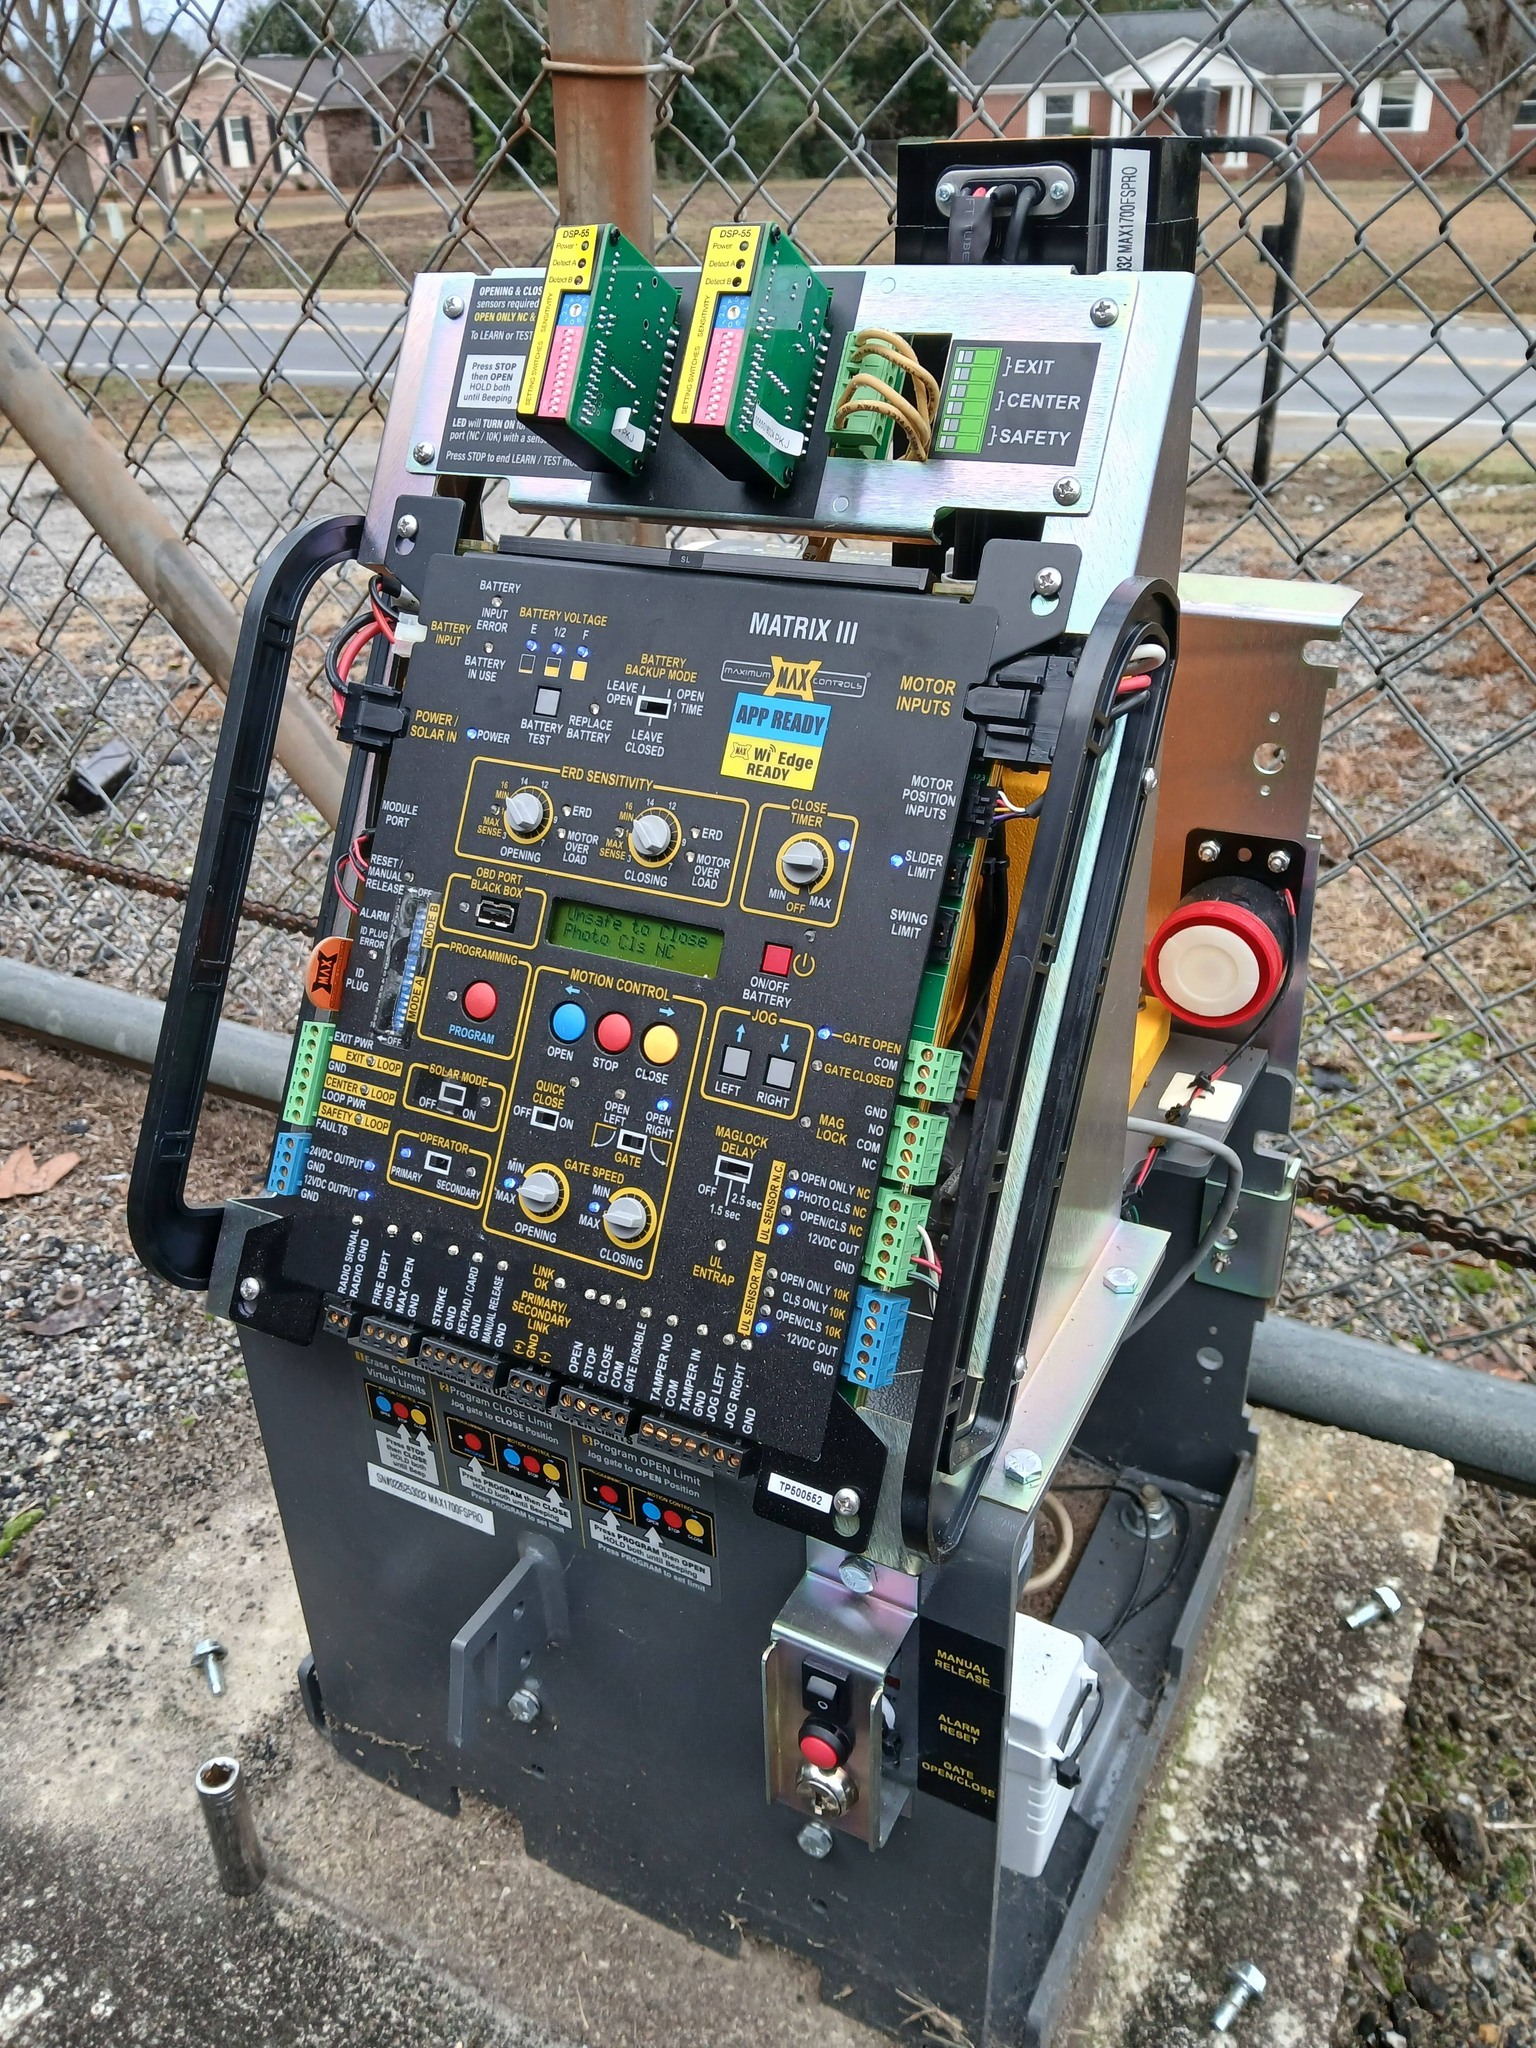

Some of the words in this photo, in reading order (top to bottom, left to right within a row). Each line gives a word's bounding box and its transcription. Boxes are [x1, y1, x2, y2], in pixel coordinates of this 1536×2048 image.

[1117, 166, 1138, 255] MAX1700FSPRO
[562, 229, 590, 238] DSP-55
[720, 229, 751, 238] DSP-55
[712, 242, 733, 250] Power
[479, 286, 514, 297] OPENING
[472, 362, 493, 372] Press
[495, 362, 517, 372] STOP
[1014, 360, 1054, 375] EXIT
[472, 372, 489, 382] then
[490, 373, 513, 382] OPEN
[469, 383, 491, 392] HOLD
[493, 383, 511, 393] both
[463, 393, 480, 402] until
[481, 394, 513, 405] Beeping
[1007, 393, 1081, 411] CENTER
[452, 418, 467, 428] LED
[467, 418, 481, 429] will
[483, 418, 502, 430] TURN
[503, 419, 515, 430] ON
[1000, 428, 1072, 446] SAFETY
[446, 451, 466, 462] Press
[467, 452, 486, 463] STOP
[487, 453, 495, 463] to
[496, 453, 510, 464] end
[511, 453, 536, 465] LEARN
[480, 580, 521, 594] BATTERY
[482, 607, 508, 620] INPUT
[519, 607, 562, 622] BATTERY
[564, 611, 608, 627] VOLTAGE
[431, 620, 471, 635] BATTERY
[476, 620, 508, 634] ERROR
[749, 612, 832, 642] MATRIX
[836, 620, 859, 645] III
[435, 633, 462, 646] INPUT
[465, 655, 506, 670] BATTERY
[640, 653, 686, 668] BATTERY
[625, 664, 666, 679] BACKUP
[667, 669, 697, 683] MODE
[724, 666, 771, 679] MAXIMUM
[606, 680, 638, 693] LEAVE
[812, 677, 863, 690] CONTROLS
[900, 675, 957, 696] MOTOR
[606, 693, 633, 707] OPEN
[676, 688, 704, 702] OPEN
[896, 696, 952, 717] INPUTS
[415, 709, 452, 725] POWER
[569, 715, 613, 731] REPLACE
[736, 705, 769, 727] APP
[770, 708, 825, 736] READY
[521, 719, 563, 734] BATTERY
[477, 729, 510, 744] POWER
[528, 733, 551, 746] TEST
[566, 728, 610, 744] BATTERY
[631, 729, 664, 744] LEAVE
[625, 742, 665, 757] CLOSED
[754, 747, 771, 763] Wi
[778, 751, 813, 770] Edge
[561, 765, 584, 780] ERD
[587, 769, 654, 791] SENSITIVITY
[746, 763, 790, 782] READY
[911, 774, 953, 790] MOTOR
[791, 798, 828, 814] CLOSE
[902, 789, 956, 807] POSITION
[381, 799, 419, 816] MODULE
[572, 806, 593, 818] ERD
[905, 803, 948, 821] INPUTS
[385, 815, 410, 828] PORT
[791, 812, 824, 828] TIMER
[567, 830, 599, 845] MOTOR
[701, 827, 724, 841] ERD
[500, 845, 541, 863] OPENING
[696, 854, 731, 869] MOTOR
[905, 850, 944, 867] SLIDER
[368, 866, 402, 881] MANUAL
[624, 869, 668, 887] CLOSING
[907, 867, 936, 880] LIMIT
[365, 879, 405, 895] RELEASE
[470, 879, 501, 895] BLACK
[502, 885, 524, 899] BOX
[768, 888, 787, 901] MIN
[809, 895, 832, 909] MAX
[786, 901, 806, 914] OFF
[360, 907, 390, 922] ALARM
[890, 908, 929, 926] SWING
[567, 905, 622, 931] Unsafe
[632, 920, 650, 936] to
[659, 924, 709, 949] Close
[891, 922, 921, 939] LIMIT
[360, 935, 385, 949] ERROR
[563, 922, 609, 947] Photo
[618, 935, 646, 955] Cls
[655, 944, 676, 960] NC
[449, 941, 519, 966] PROGRAMMING
[569, 968, 614, 990] MOTION
[616, 978, 672, 1003] CONTROL
[750, 976, 790, 993] ON/OFF
[742, 989, 792, 1010] BATTERY
[750, 1009, 778, 1027] JOG
[448, 1024, 495, 1044] PROGRAM
[842, 1032, 870, 1048] GATE
[872, 1039, 902, 1055] OPEN
[547, 1046, 574, 1061] OPEN
[592, 1056, 619, 1072] STOP
[873, 1056, 899, 1071] COM
[635, 1067, 669, 1085] CLOSE
[824, 1062, 851, 1079] GATE
[852, 1069, 895, 1089] CLOSED
[326, 1076, 359, 1094] CENTER
[371, 1087, 396, 1103] LOOP
[536, 1080, 567, 1097] QUICK
[715, 1080, 741, 1097] LEFT
[532, 1092, 565, 1110] CLOSE
[756, 1091, 791, 1110] RIGHT
[315, 1118, 348, 1136] FAULTS
[320, 1104, 354, 1121] SAFETY
[365, 1117, 389, 1132] LOOP
[819, 1113, 846, 1130] MAG
[420, 1131, 470, 1155] OPERATOR
[715, 1125, 770, 1149] MAGLOCK
[815, 1127, 848, 1146] LOCK
[614, 1151, 642, 1168] GATE
[721, 1141, 758, 1160] DELAY
[391, 1165, 423, 1183] PRIMARY
[564, 1159, 590, 1175] GATE
[592, 1166, 625, 1185] SPEED
[436, 1179, 482, 1201] SECONDARY
[514, 1222, 558, 1244] OPENING
[600, 1247, 644, 1270] CLOSING
[692, 1264, 736, 1286] ENTRAP
[432, 1285, 449, 1327] STRIKE
[511, 1301, 572, 1328] SECONDARY
[527, 1318, 550, 1335] LINK
[583, 1346, 598, 1379] STOP
[598, 1343, 615, 1384] CLOSE
[366, 1367, 397, 1384] Virtual
[398, 1379, 427, 1396] Limits
[450, 1386, 491, 1409] Program
[493, 1401, 526, 1420] CLOSE
[527, 1414, 554, 1431] Limit
[593, 1438, 637, 1462] Program
[640, 1457, 671, 1475] OPEN
[673, 1469, 702, 1487] Limit
[663, 1477, 701, 1499] Position
[937, 1649, 990, 1677] MANUAL
[934, 1660, 991, 1689] RELEASE
[938, 1713, 981, 1737] ALARM
[940, 1723, 979, 1746] RESET
[943, 1761, 974, 1780] GATE
[921, 1761, 996, 1800] OPEN/CLOSE
